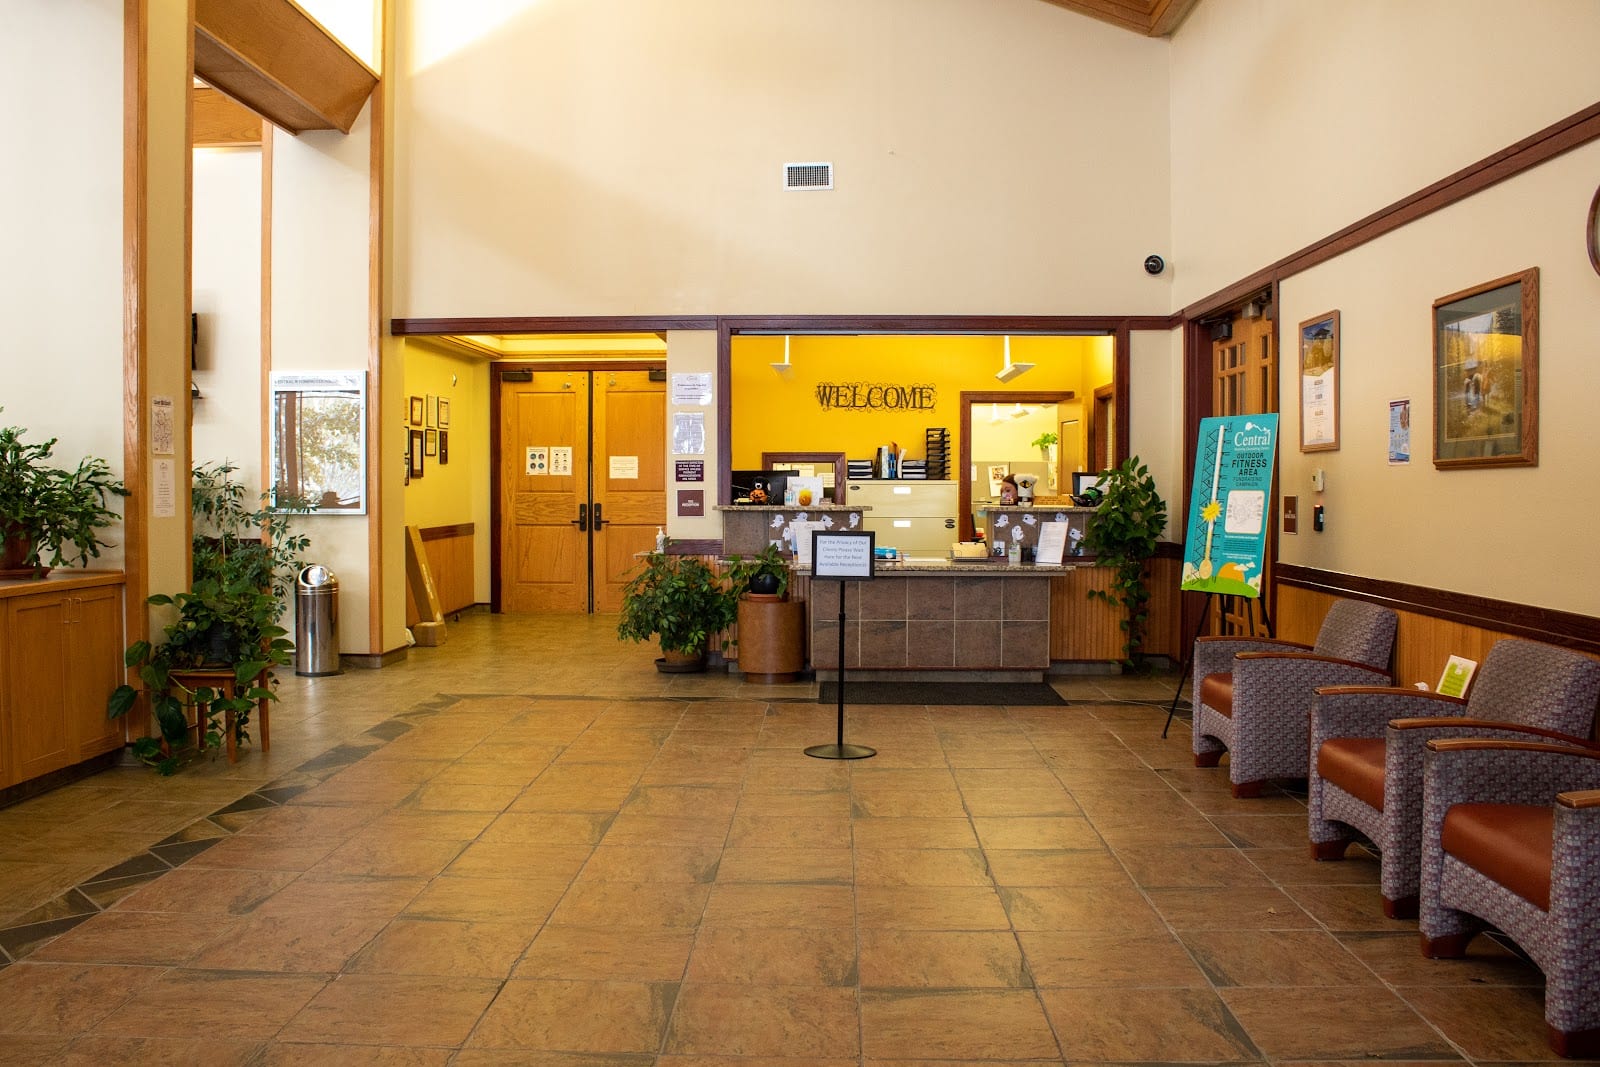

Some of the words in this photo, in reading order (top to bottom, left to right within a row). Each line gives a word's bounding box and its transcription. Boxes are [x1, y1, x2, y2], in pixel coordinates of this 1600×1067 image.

[816, 383, 936, 410] WELCOME
[1234, 431, 1271, 446] Central
[1231, 459, 1267, 468] FITNESS
[1238, 468, 1258, 476] AREA
